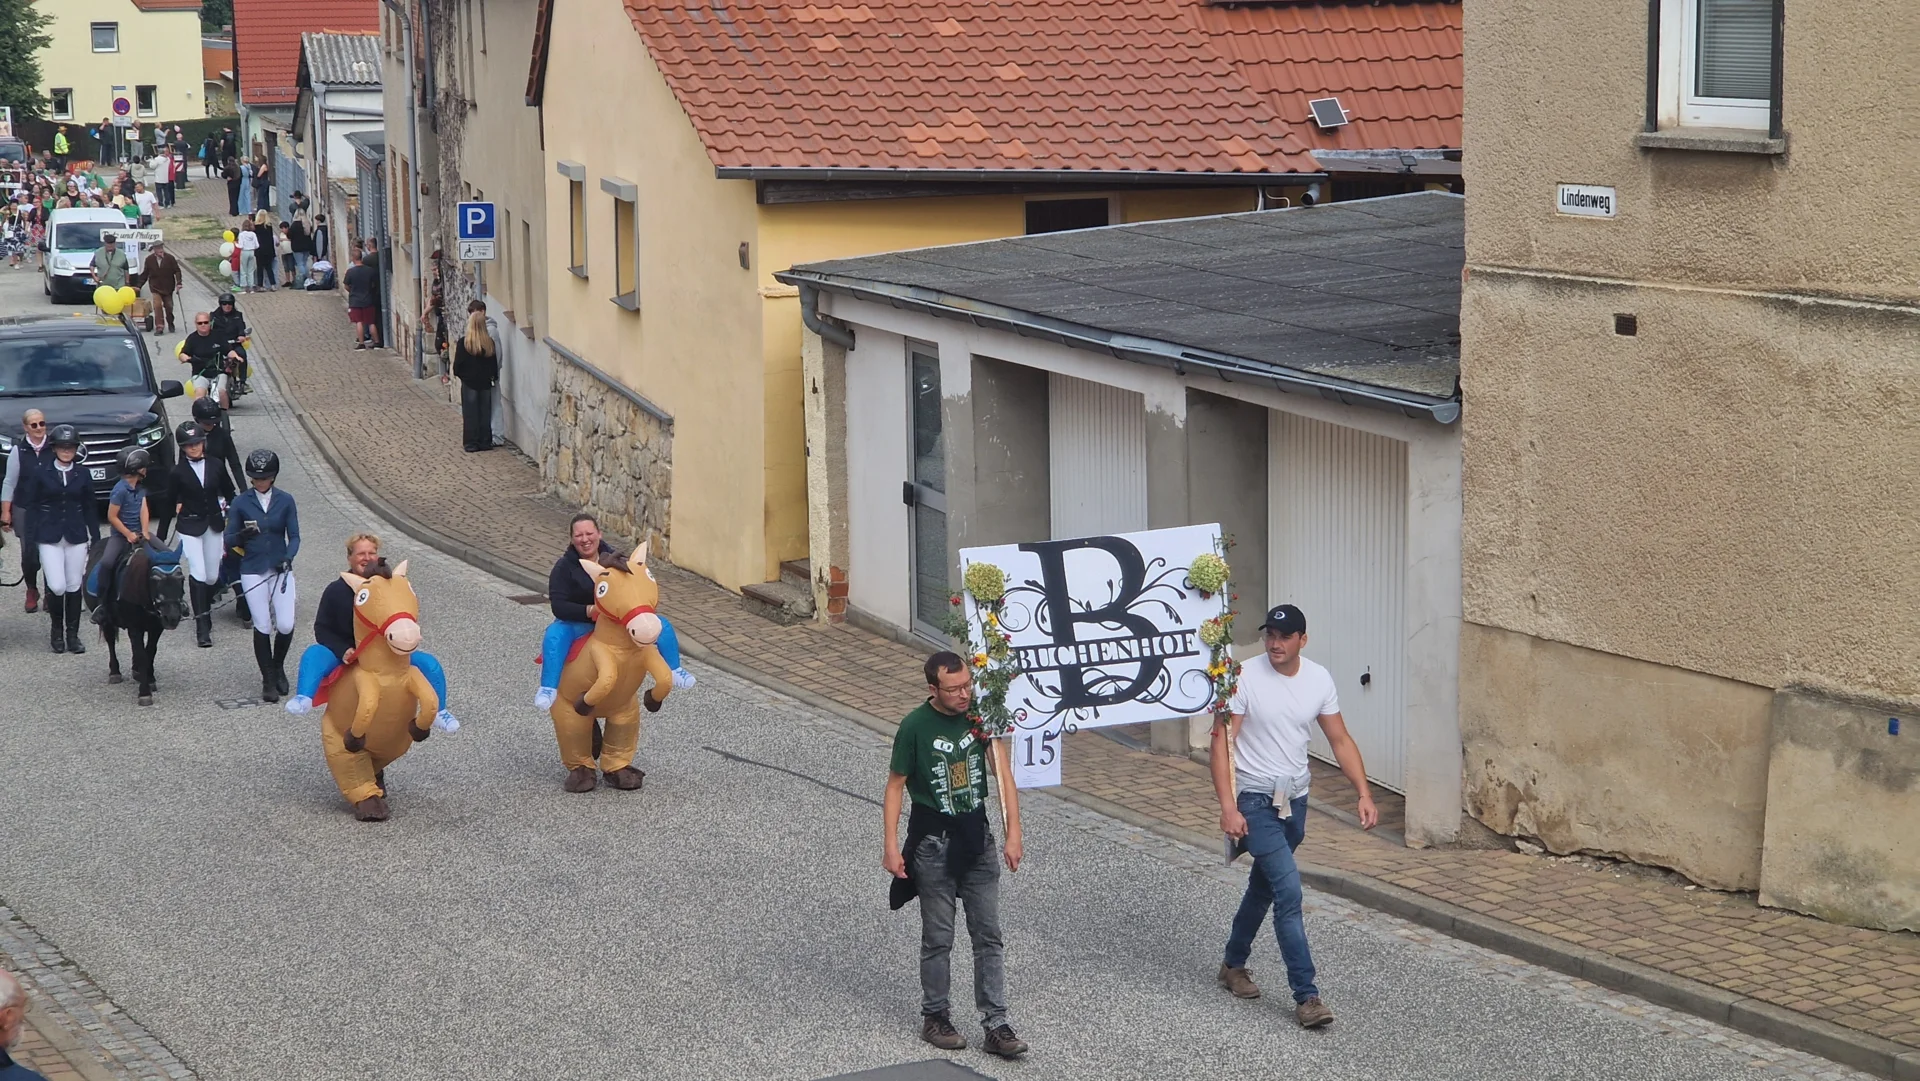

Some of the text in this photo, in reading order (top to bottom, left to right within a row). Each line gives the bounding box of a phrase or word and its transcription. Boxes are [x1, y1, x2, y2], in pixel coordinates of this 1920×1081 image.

[1561, 187, 1611, 214] Lindenweg
[466, 207, 486, 235] P
[127, 245, 137, 253] 17
[93, 469, 105, 479] 25
[1016, 631, 1198, 671] BUCHENHOF
[1023, 729, 1056, 767] 15
